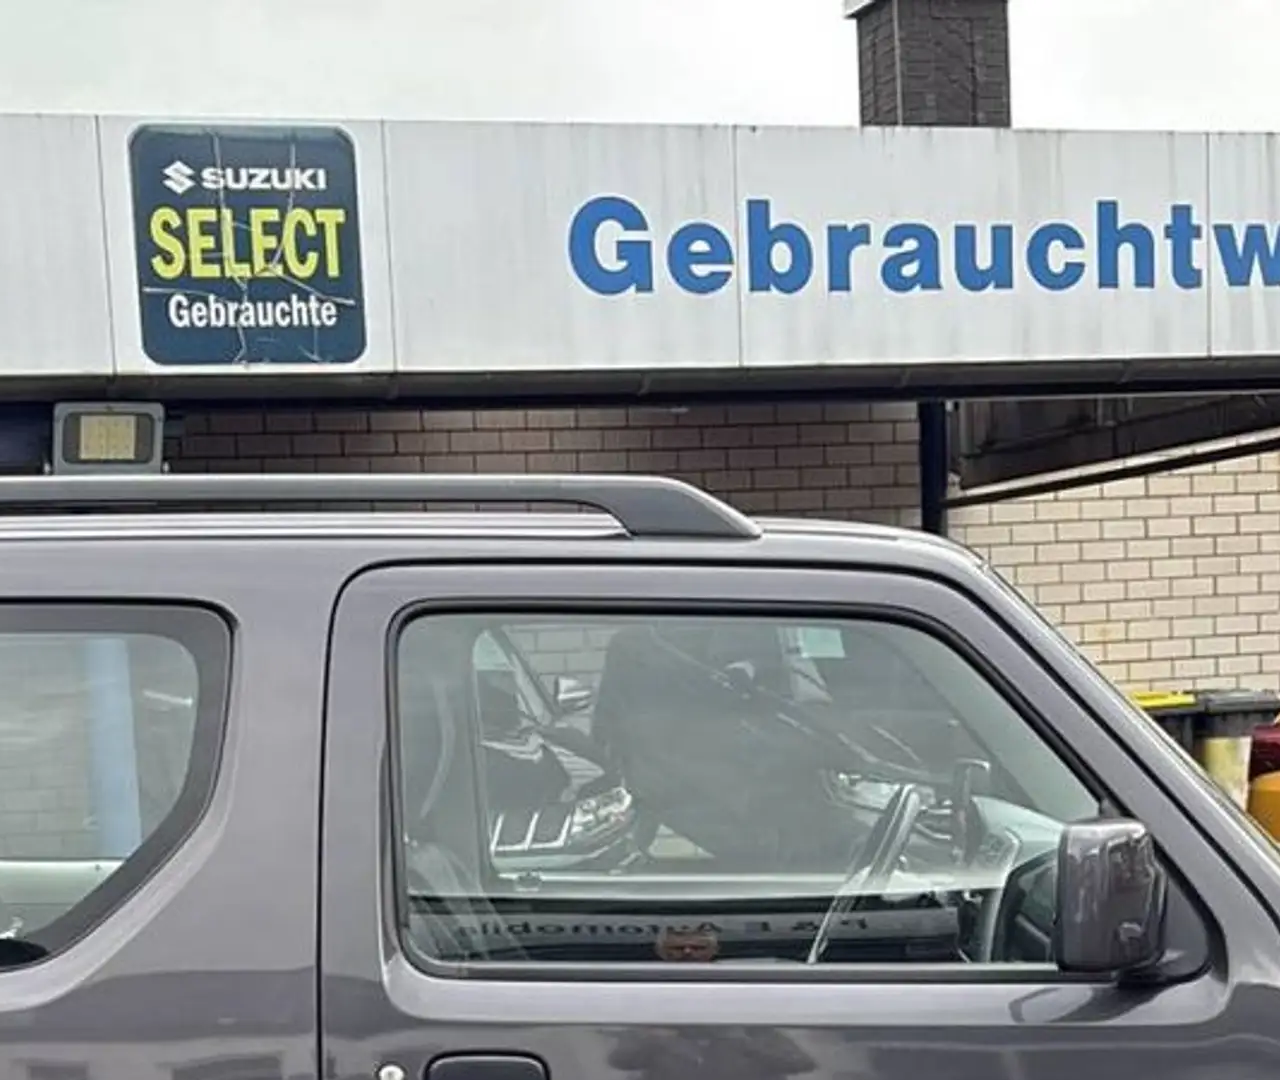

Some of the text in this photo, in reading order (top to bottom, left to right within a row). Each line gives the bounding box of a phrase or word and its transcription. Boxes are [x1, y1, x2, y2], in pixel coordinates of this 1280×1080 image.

[201, 167, 328, 191] SUZUKI
[150, 206, 346, 280] SELECT
[169, 295, 337, 329] Gebrauchte
